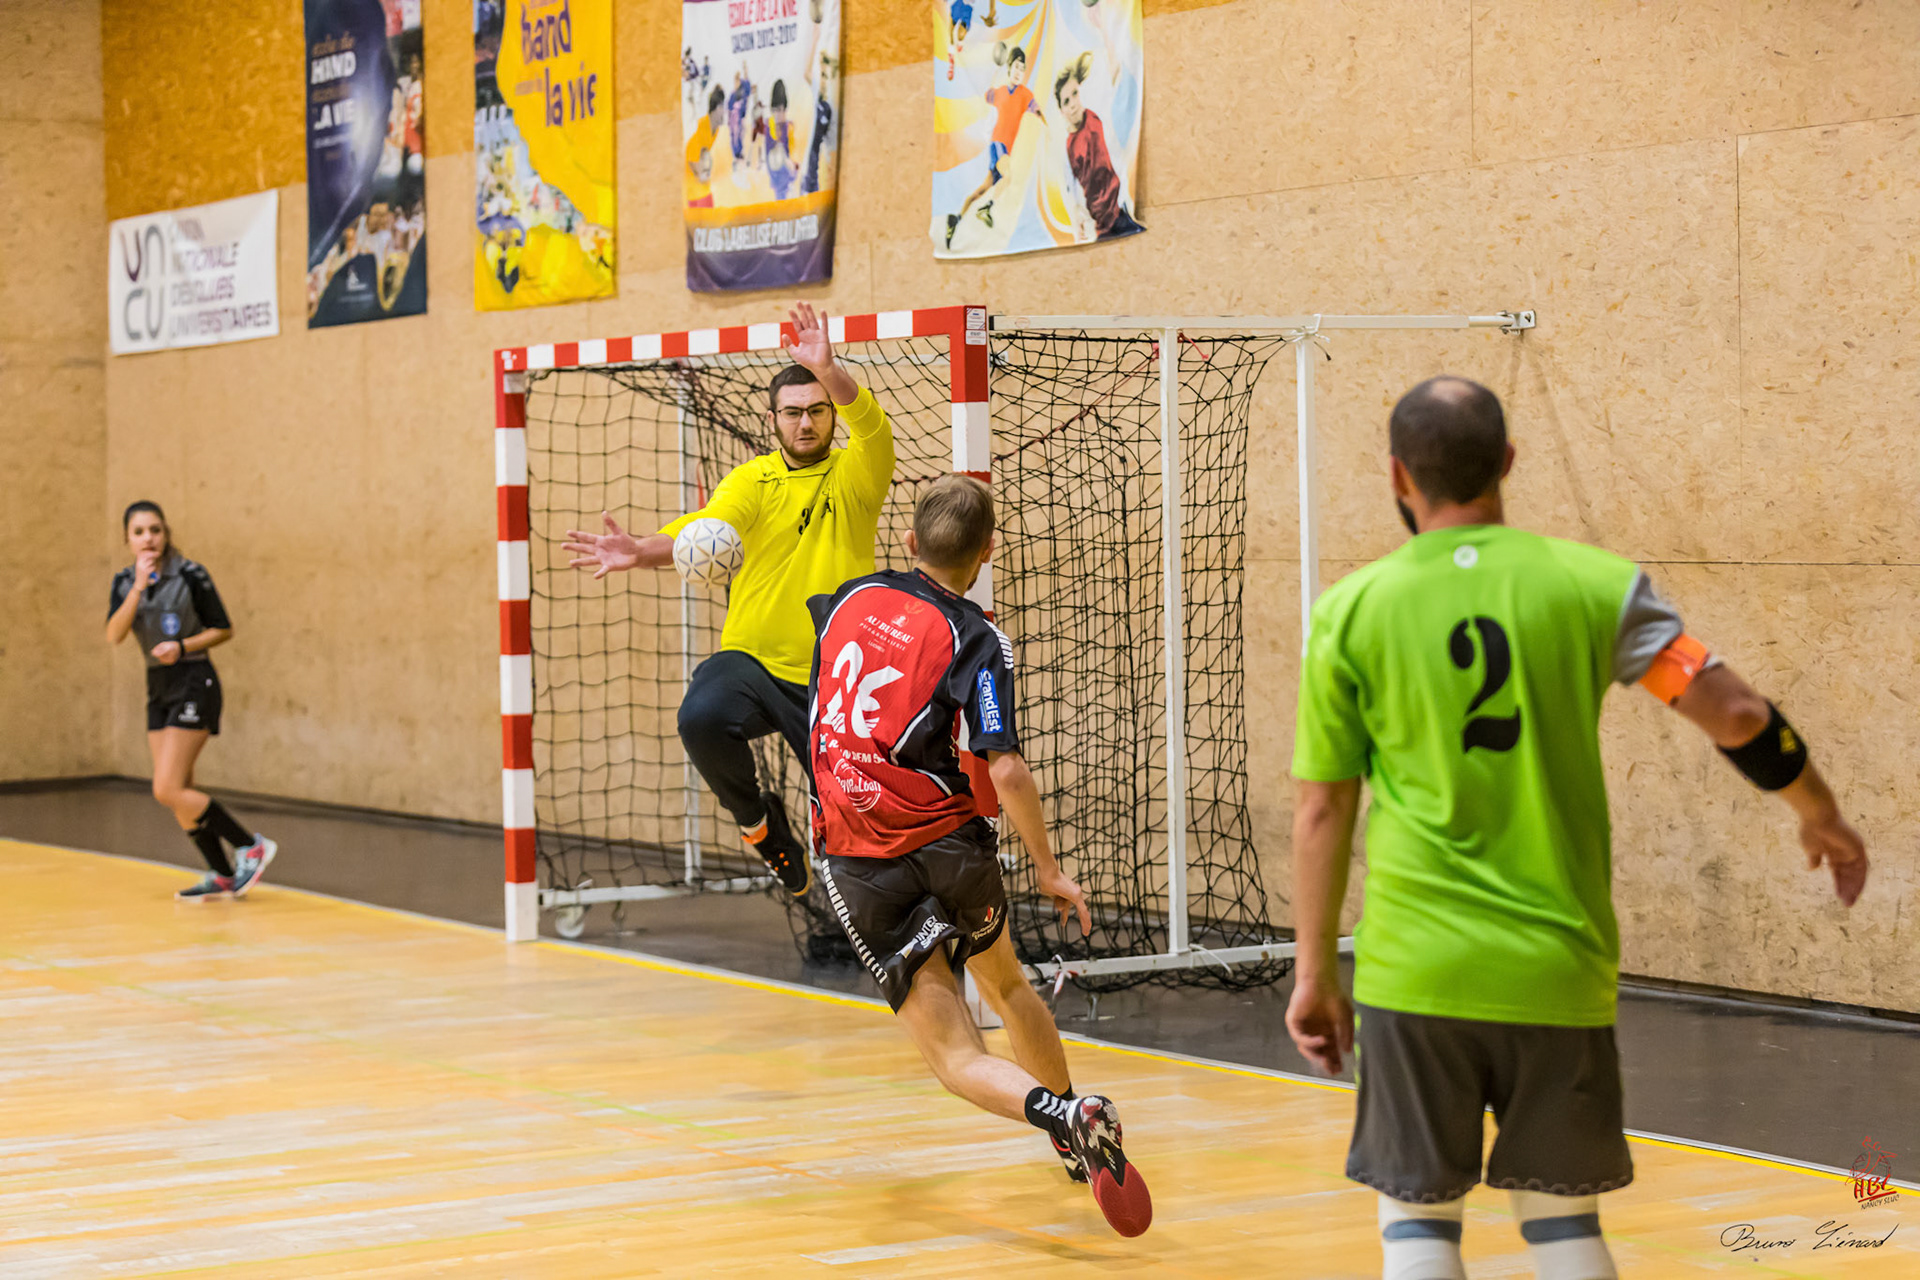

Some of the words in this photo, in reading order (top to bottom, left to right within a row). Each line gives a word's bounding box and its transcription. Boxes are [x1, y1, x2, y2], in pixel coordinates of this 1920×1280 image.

[521, 0, 572, 65] hand
[545, 67, 563, 127] la
[567, 61, 597, 121] vie
[864, 615, 881, 626] AU
[878, 622, 914, 643] BUREAU
[1448, 614, 1521, 754] 2
